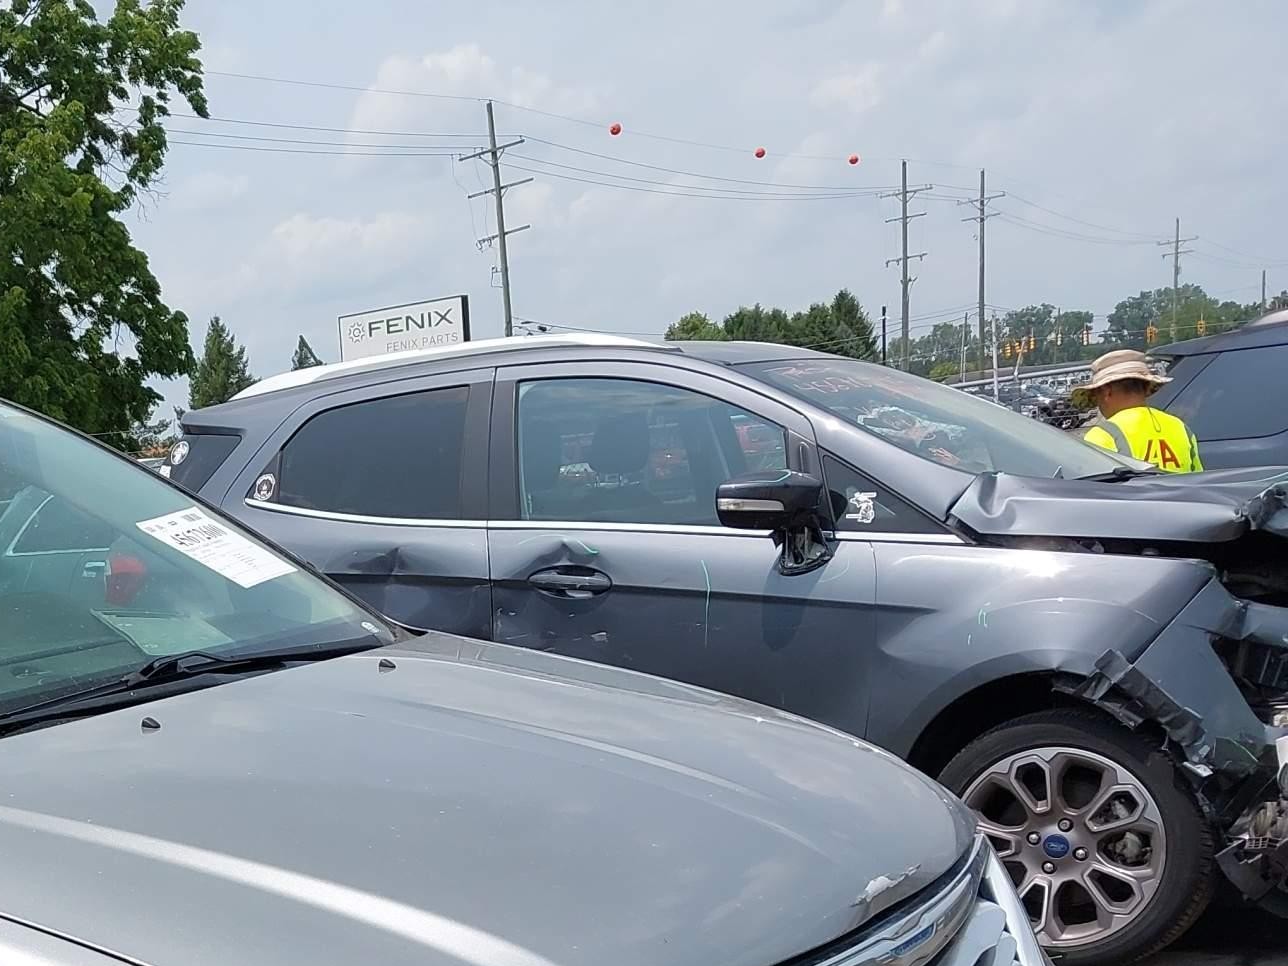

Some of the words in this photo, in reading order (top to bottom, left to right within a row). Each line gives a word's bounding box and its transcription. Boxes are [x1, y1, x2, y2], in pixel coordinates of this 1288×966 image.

[368, 308, 453, 337] FENIX
[386, 340, 418, 352] FENIX
[422, 332, 458, 347] PARTS
